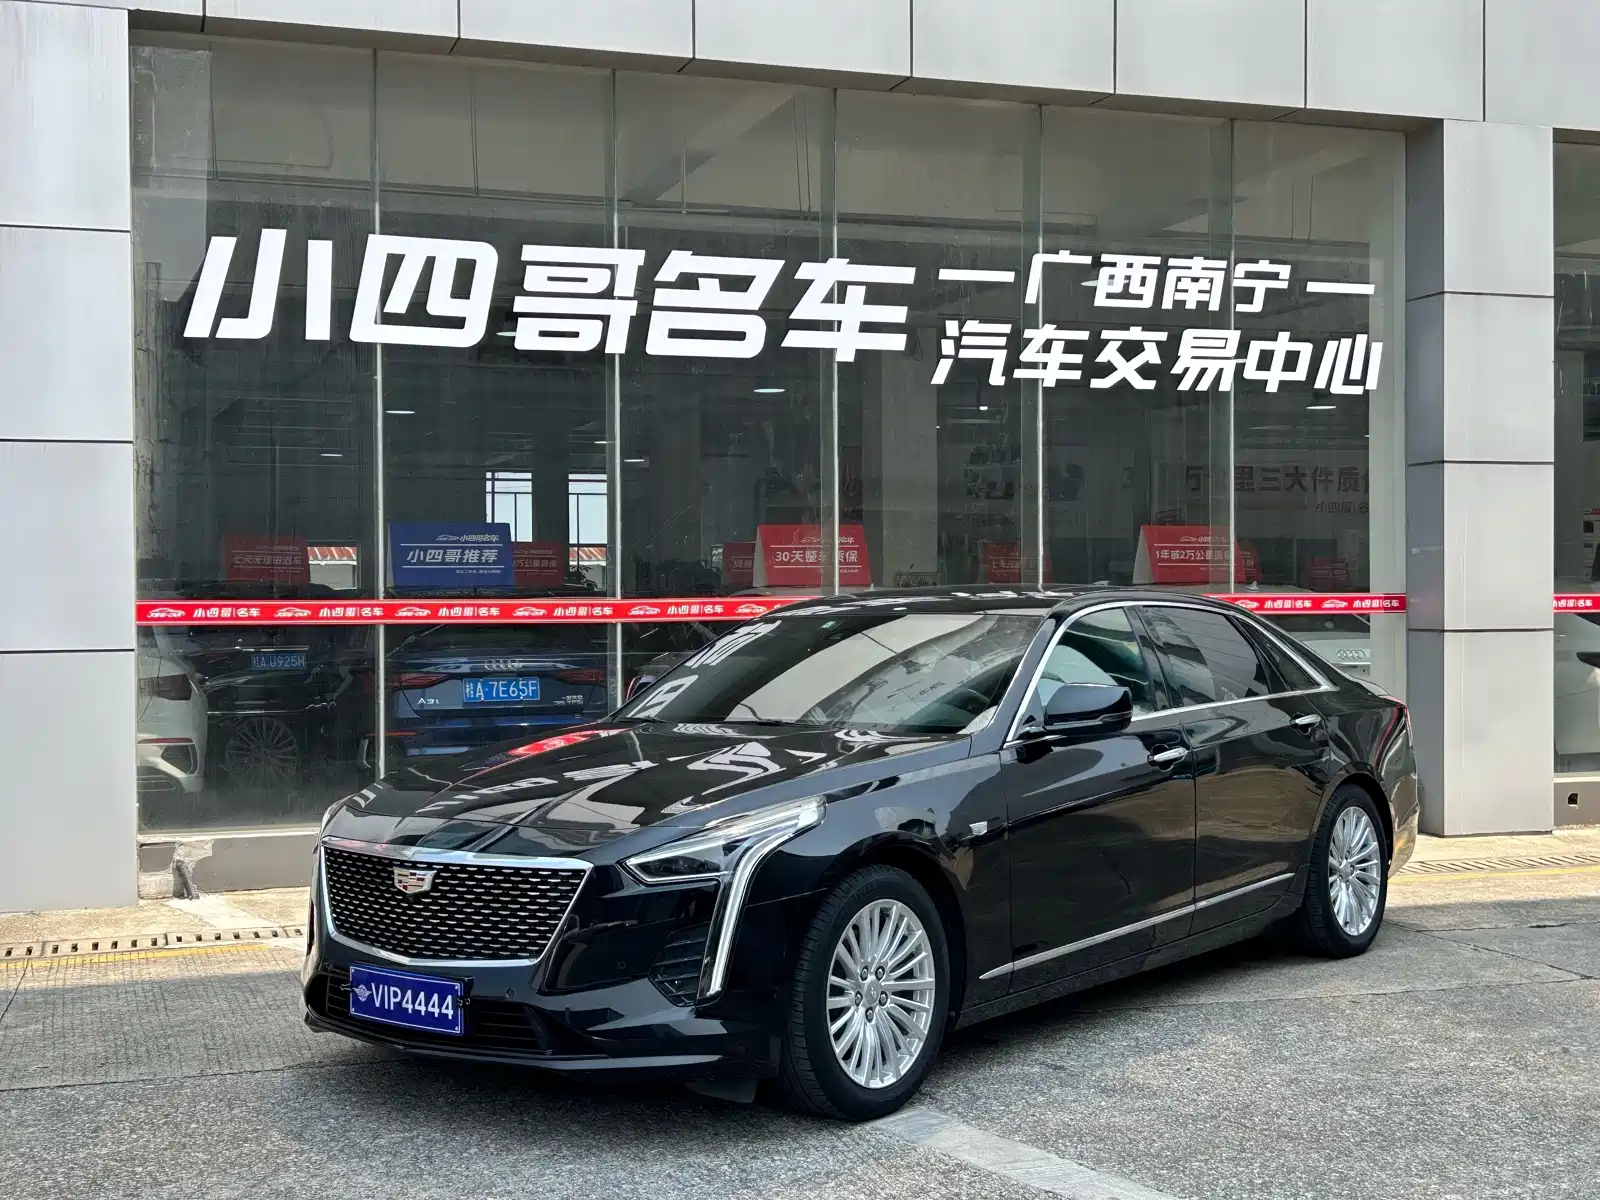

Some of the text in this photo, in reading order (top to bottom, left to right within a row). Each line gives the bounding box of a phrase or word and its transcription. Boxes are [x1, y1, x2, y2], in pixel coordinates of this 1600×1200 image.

[183, 228, 917, 362] 小四哥名车
[930, 319, 1385, 396] 汽车交易中心
[406, 548, 500, 564] 小四哥推荐
[371, 982, 454, 1020] VIP4444
